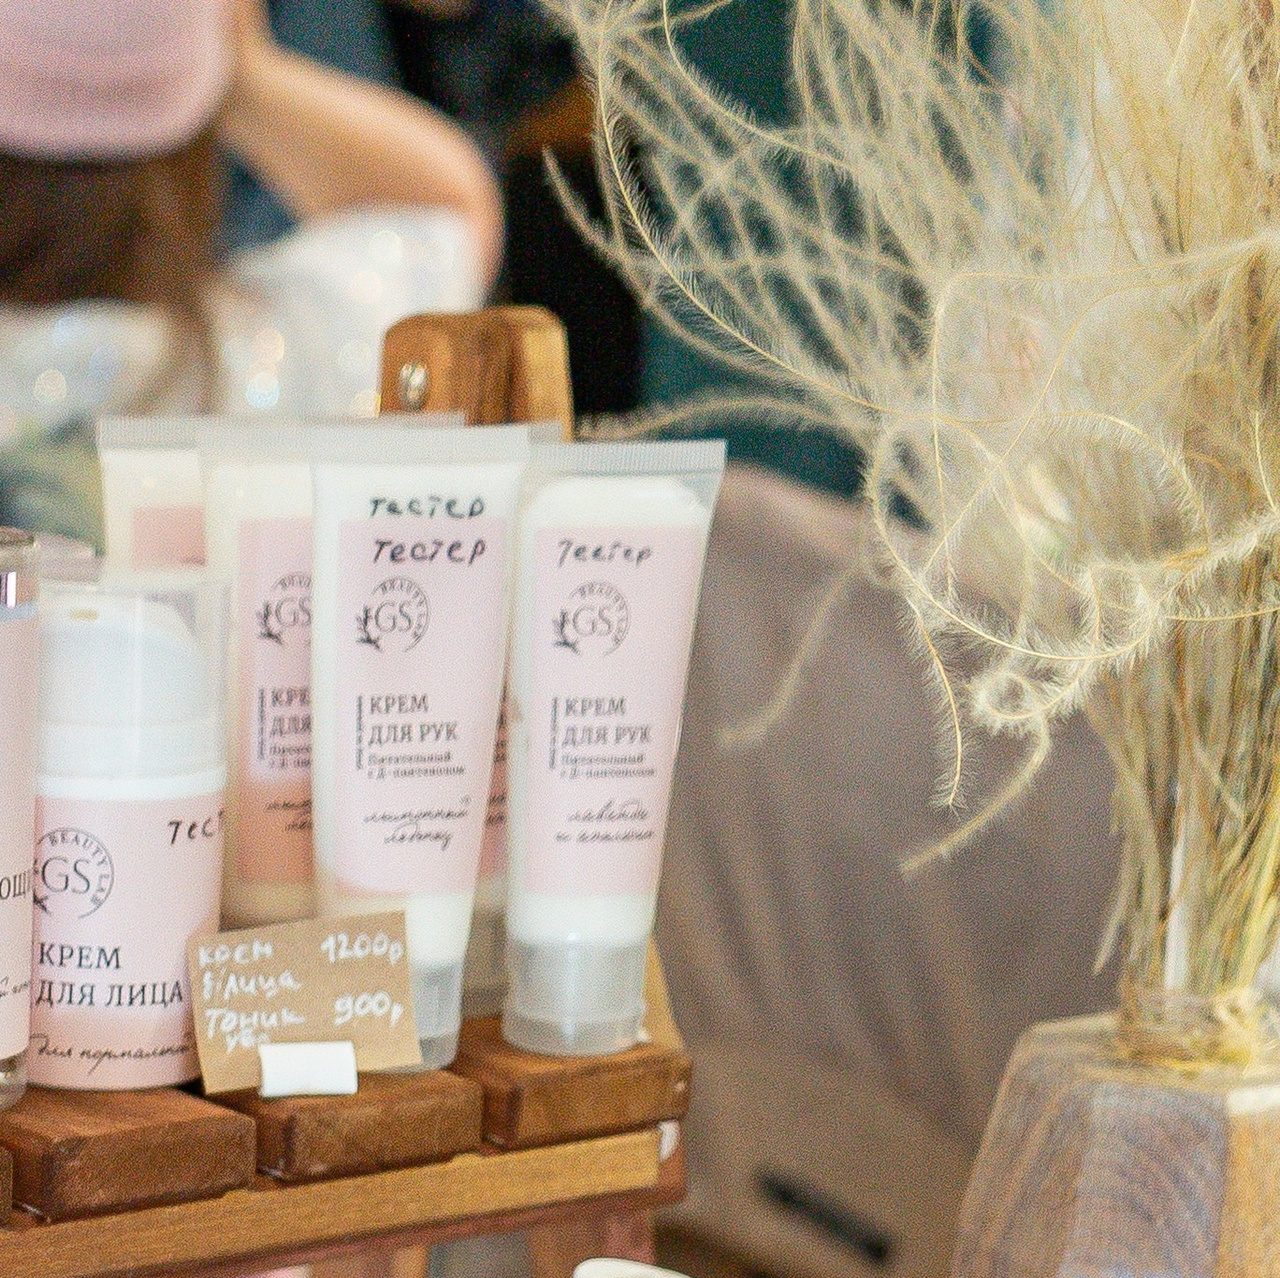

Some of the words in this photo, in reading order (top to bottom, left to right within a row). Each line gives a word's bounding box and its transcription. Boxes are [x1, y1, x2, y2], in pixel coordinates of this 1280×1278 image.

[369, 693, 429, 715] КРЕМ
[564, 697, 627, 718] КРЕМ
[368, 724, 413, 746] ДЛЯ
[419, 722, 459, 743] РУК
[561, 726, 609, 748] ДЛЯ
[615, 724, 652, 744] РУК
[41, 856, 91, 893] GS
[37, 942, 121, 970] КРЕМ
[35, 980, 95, 1008] ДЛЯ
[104, 980, 183, 1009] ЛИЦА
